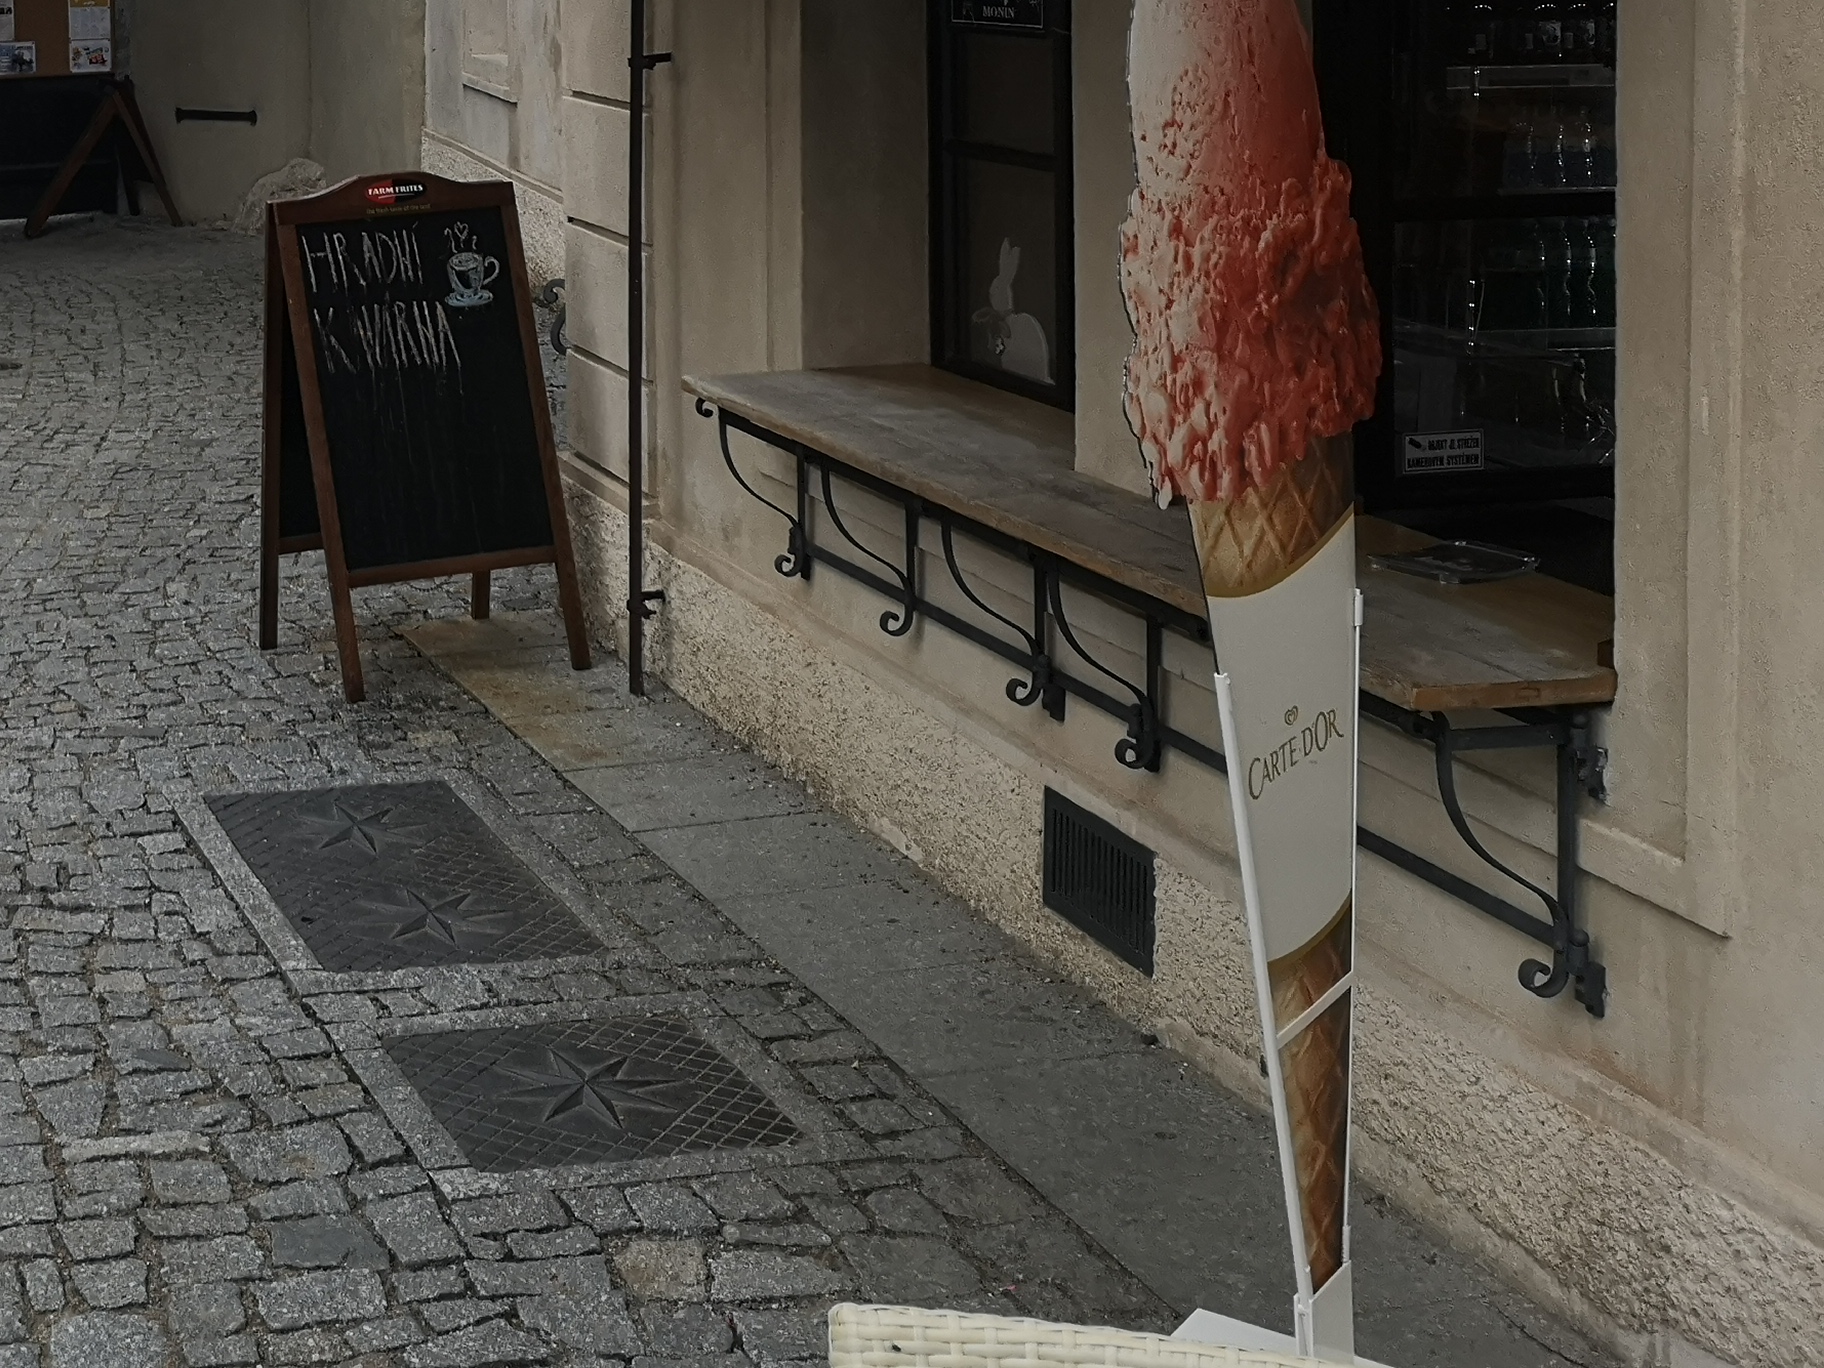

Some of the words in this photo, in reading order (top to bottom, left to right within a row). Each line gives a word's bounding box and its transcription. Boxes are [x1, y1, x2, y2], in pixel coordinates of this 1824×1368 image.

[982, 5, 1016, 19] MONIN
[367, 186, 394, 196] FARM
[395, 184, 424, 193] FRITES
[301, 221, 425, 295] HRADNÍ
[1248, 736, 1299, 800] CARTE
